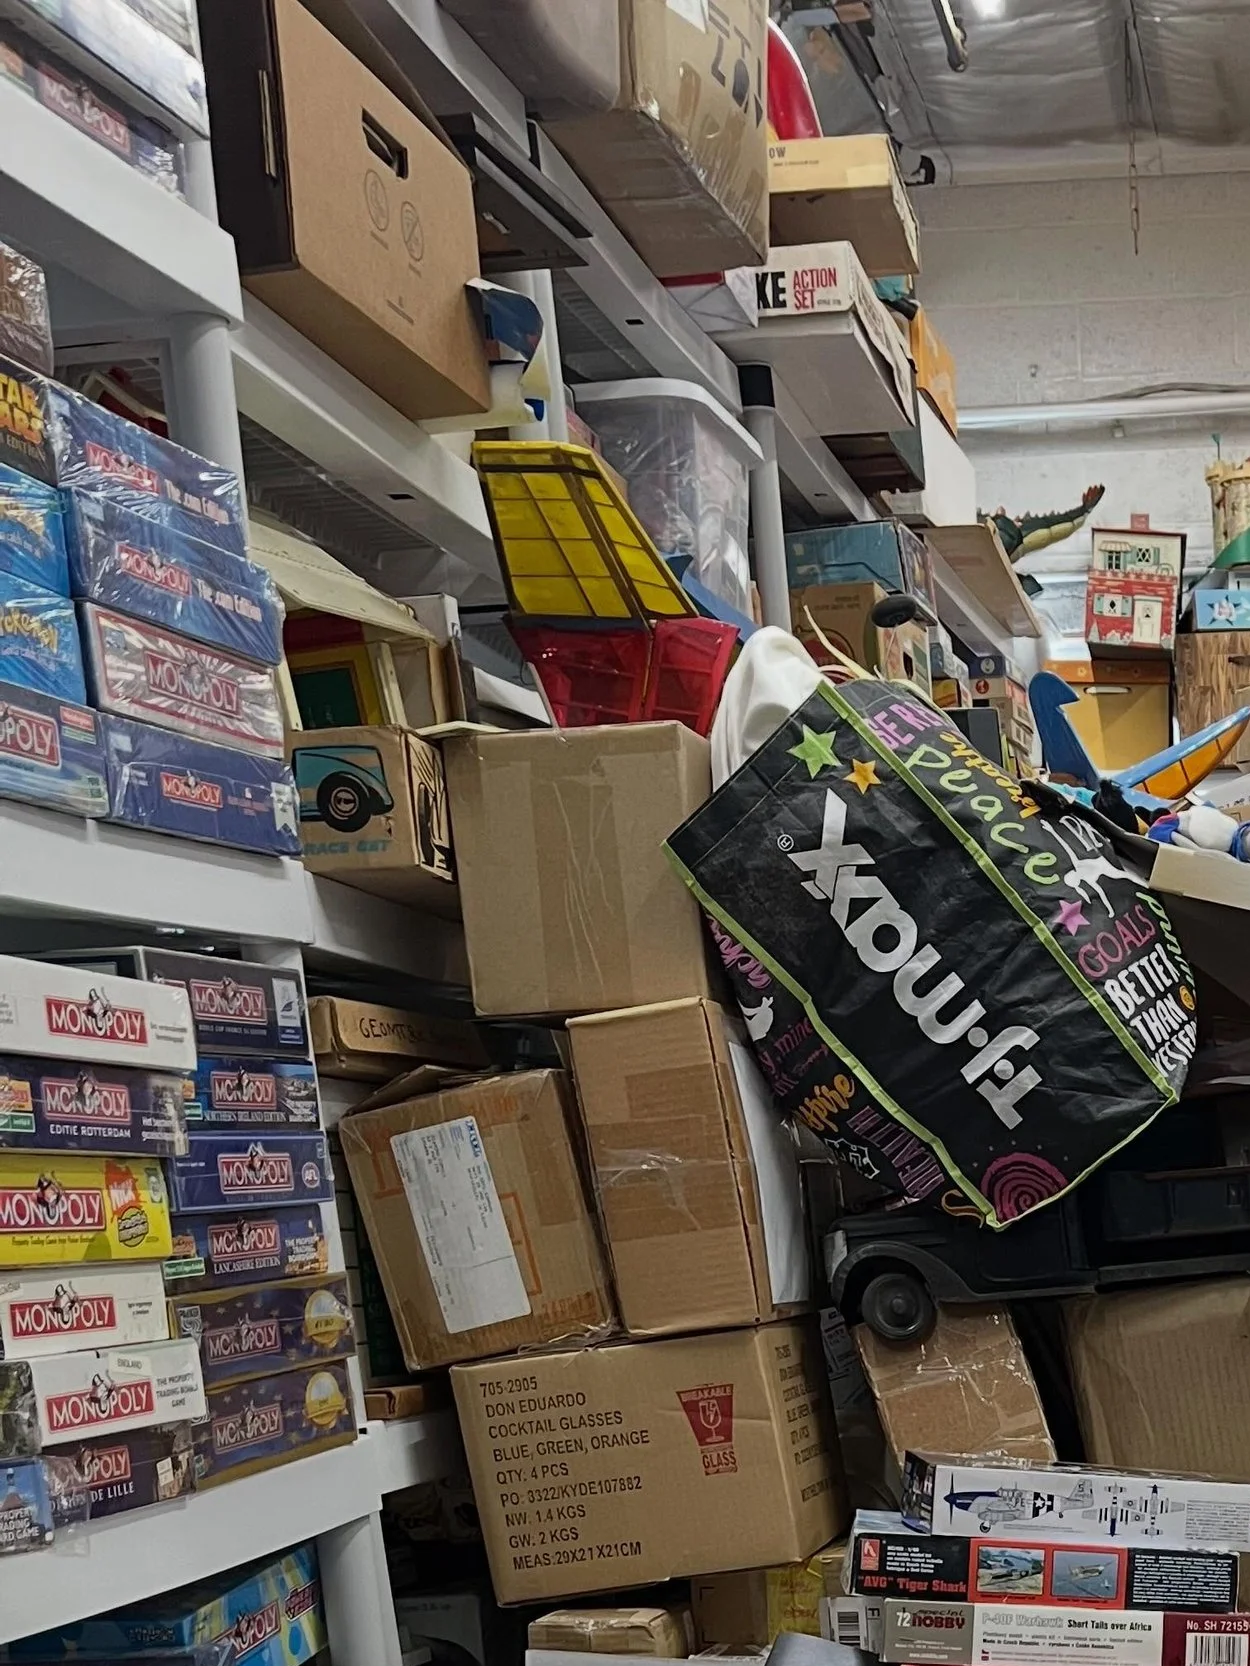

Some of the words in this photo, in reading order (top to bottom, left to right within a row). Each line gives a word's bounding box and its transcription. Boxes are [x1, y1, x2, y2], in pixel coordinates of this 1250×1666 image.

[793, 266, 837, 291] ACTION
[794, 289, 817, 310] SET
[150, 660, 238, 712] MONOPOLY
[162, 777, 221, 804] MONOPOLY
[1077, 905, 1156, 981] GOALS
[1104, 943, 1181, 1018] BETTER
[194, 986, 264, 1017] MONOPOLY
[51, 1011, 143, 1040] MONOPOLY
[1130, 1002, 1181, 1047] THAN
[46, 1092, 128, 1116] MONOPOLY
[213, 1081, 274, 1103] MONOPOLY
[50, 1124, 78, 1136] EDITIE
[80, 1127, 131, 1138] ROTTERDAM
[223, 1161, 290, 1185] MONOPOLY
[213, 1228, 277, 1253] MONOPOLY
[213, 1258, 254, 1274] LANCASHIRE
[255, 1256, 281, 1269] EDITION
[14, 1304, 113, 1333] MONOPOLY
[209, 1326, 278, 1356] MONOPOLY
[117, 1359, 143, 1369] ENGLAND
[51, 1386, 148, 1426] MONOPOLY
[485, 1402, 516, 1418] DON
[519, 1392, 586, 1414] EDUARDO
[215, 1411, 281, 1443] MONOPOLY
[488, 1420, 557, 1439] COCKTAIL
[559, 1410, 623, 1429] GLASSES
[493, 1445, 535, 1463] BLUE,
[536, 1439, 588, 1458] GREEN,
[590, 1430, 650, 1449] ORANGE
[702, 1451, 737, 1471] GLASS
[496, 1467, 528, 1486] QTY:
[530, 1464, 539, 1480] 4
[541, 1462, 569, 1479] PCS
[91, 1491, 105, 1502] DE
[107, 1481, 135, 1499] LILLE
[500, 1492, 526, 1508] PO:
[527, 1476, 642, 1504] 3322/KYDE107882
[504, 1511, 531, 1528] NW:
[535, 1509, 554, 1524] 1.4
[556, 1505, 586, 1521] KGS
[508, 1533, 536, 1549] GW:
[539, 1532, 548, 1545] 2
[550, 1527, 579, 1543] KGS
[897, 1578, 929, 1592] Tiger
[932, 1579, 967, 1593] Shark
[1015, 1614, 1064, 1629] Warhawk
[1068, 1618, 1086, 1629] Short
[1090, 1620, 1108, 1630] Tails
[1110, 1622, 1128, 1630] over
[1129, 1621, 1152, 1631] Africa
[1186, 1620, 1201, 1631] No.
[1203, 1620, 1217, 1631] SH
[1219, 1620, 1249, 1632] 72155
